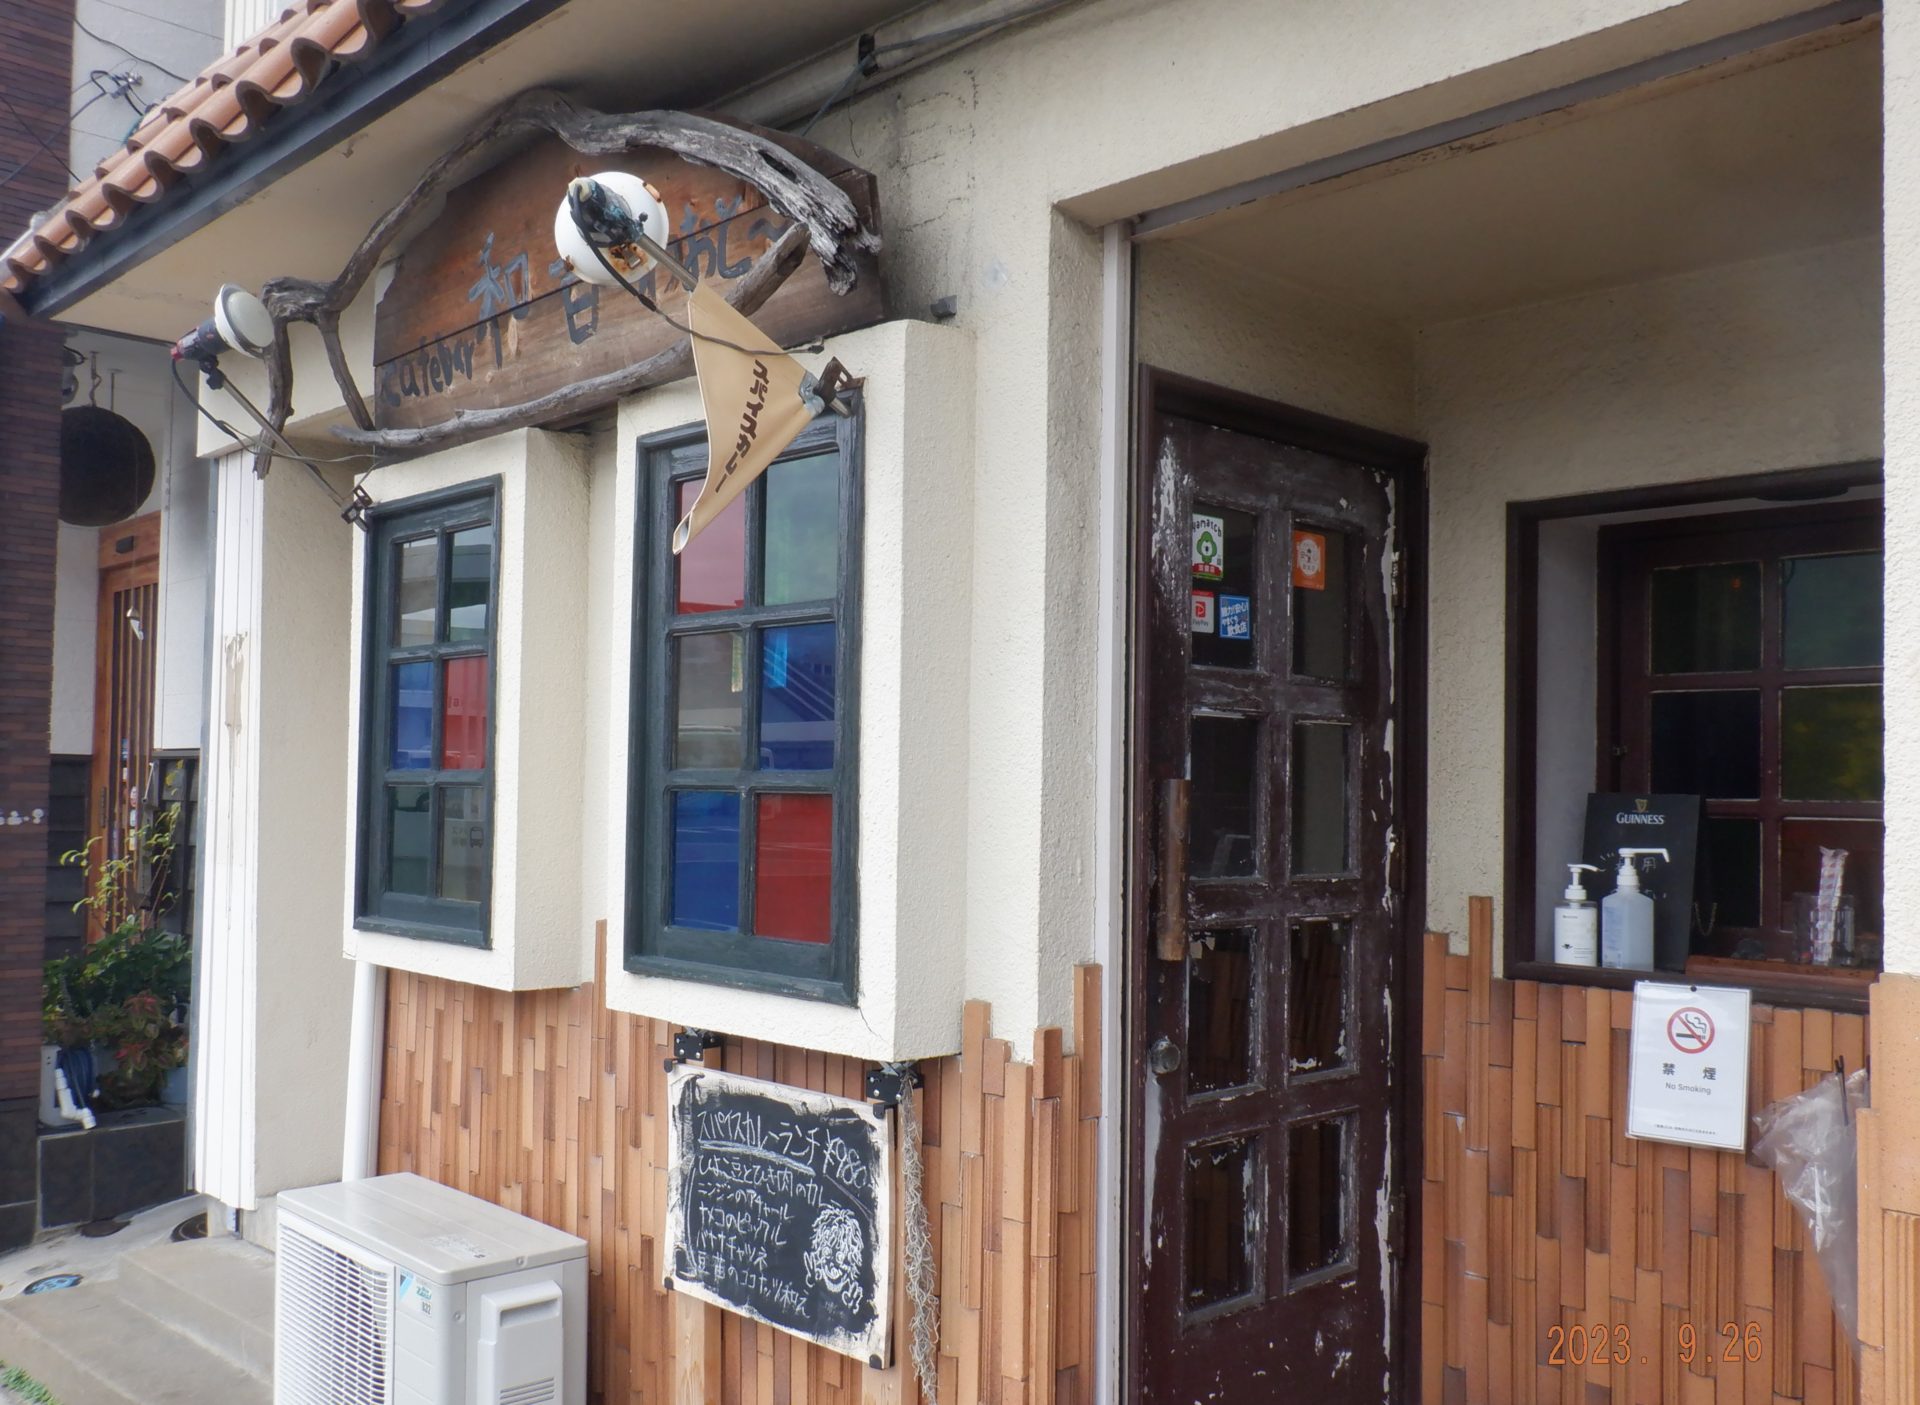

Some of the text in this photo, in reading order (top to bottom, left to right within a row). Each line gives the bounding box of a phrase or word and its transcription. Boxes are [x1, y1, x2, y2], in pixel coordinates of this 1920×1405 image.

[715, 359, 770, 493] スパイスカレー
[1616, 811, 1665, 826] GUINNESS
[1665, 1081, 1712, 1095] No Smoking
